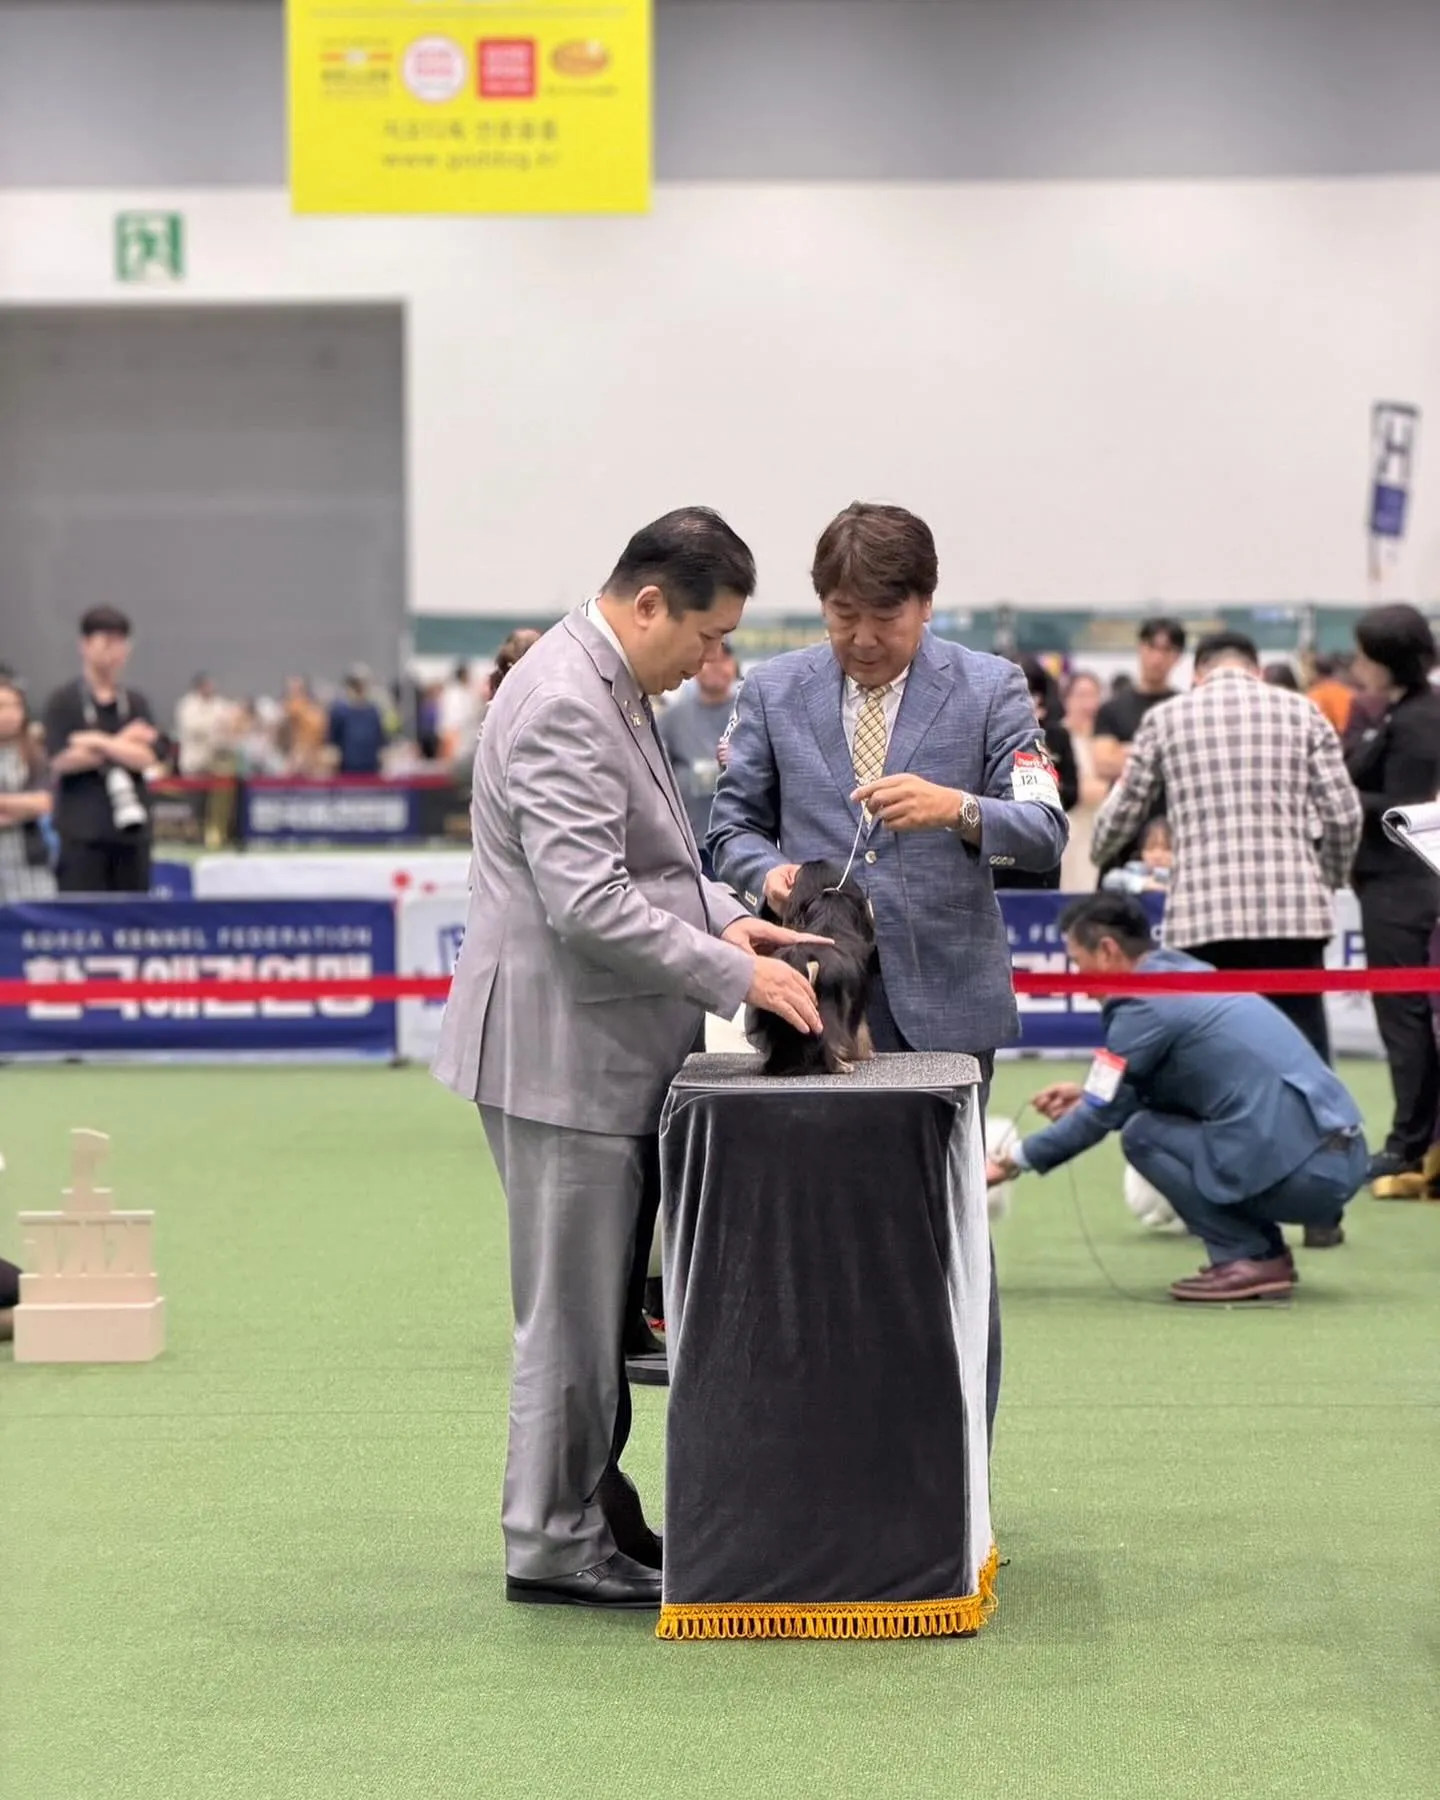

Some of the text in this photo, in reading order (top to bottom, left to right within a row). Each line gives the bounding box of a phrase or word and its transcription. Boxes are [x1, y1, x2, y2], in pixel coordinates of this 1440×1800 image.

[1021, 775, 1038, 785] 121
[22, 926, 373, 950] KOREA KENNEL FEDERATION
